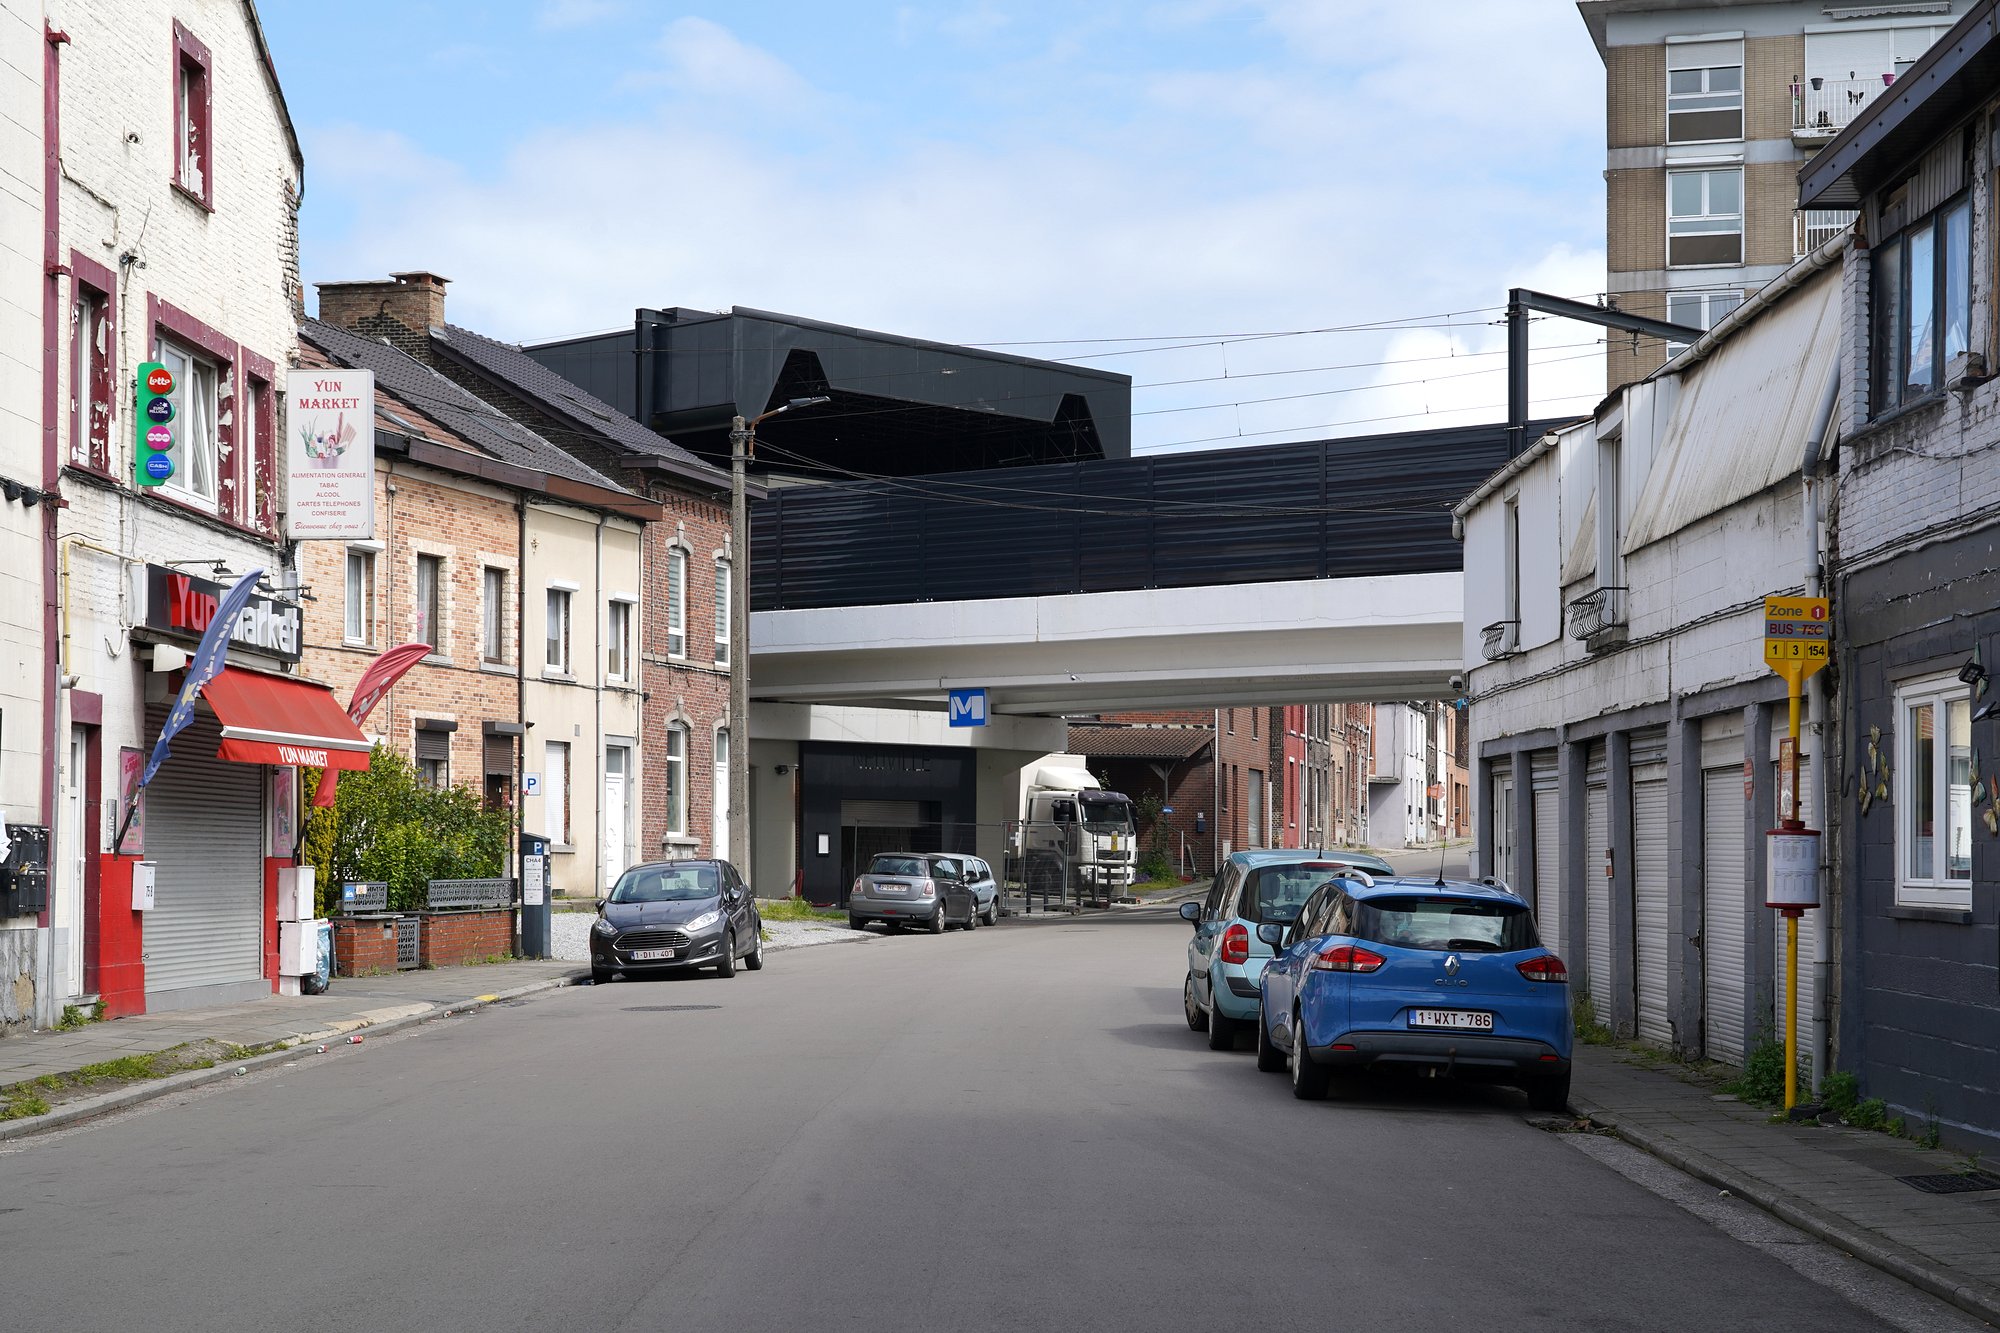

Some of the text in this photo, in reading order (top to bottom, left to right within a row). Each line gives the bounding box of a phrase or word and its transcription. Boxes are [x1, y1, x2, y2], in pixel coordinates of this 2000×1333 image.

[314, 379, 342, 392] YUN
[299, 398, 360, 409] MARKET
[294, 521, 327, 530] Bienvenue
[329, 522, 343, 531] chez
[166, 573, 299, 654] Yun arket
[1769, 605, 1820, 618] Zone 1
[1769, 624, 1824, 635] BUS TEC
[1773, 645, 1825, 656] 1 3 154
[278, 746, 328, 767] YUN MARKET
[527, 778, 536, 790] P
[534, 841, 542, 853] P
[1434, 978, 1468, 987] CLIO
[1418, 1011, 1491, 1027] 1-WXT-786
